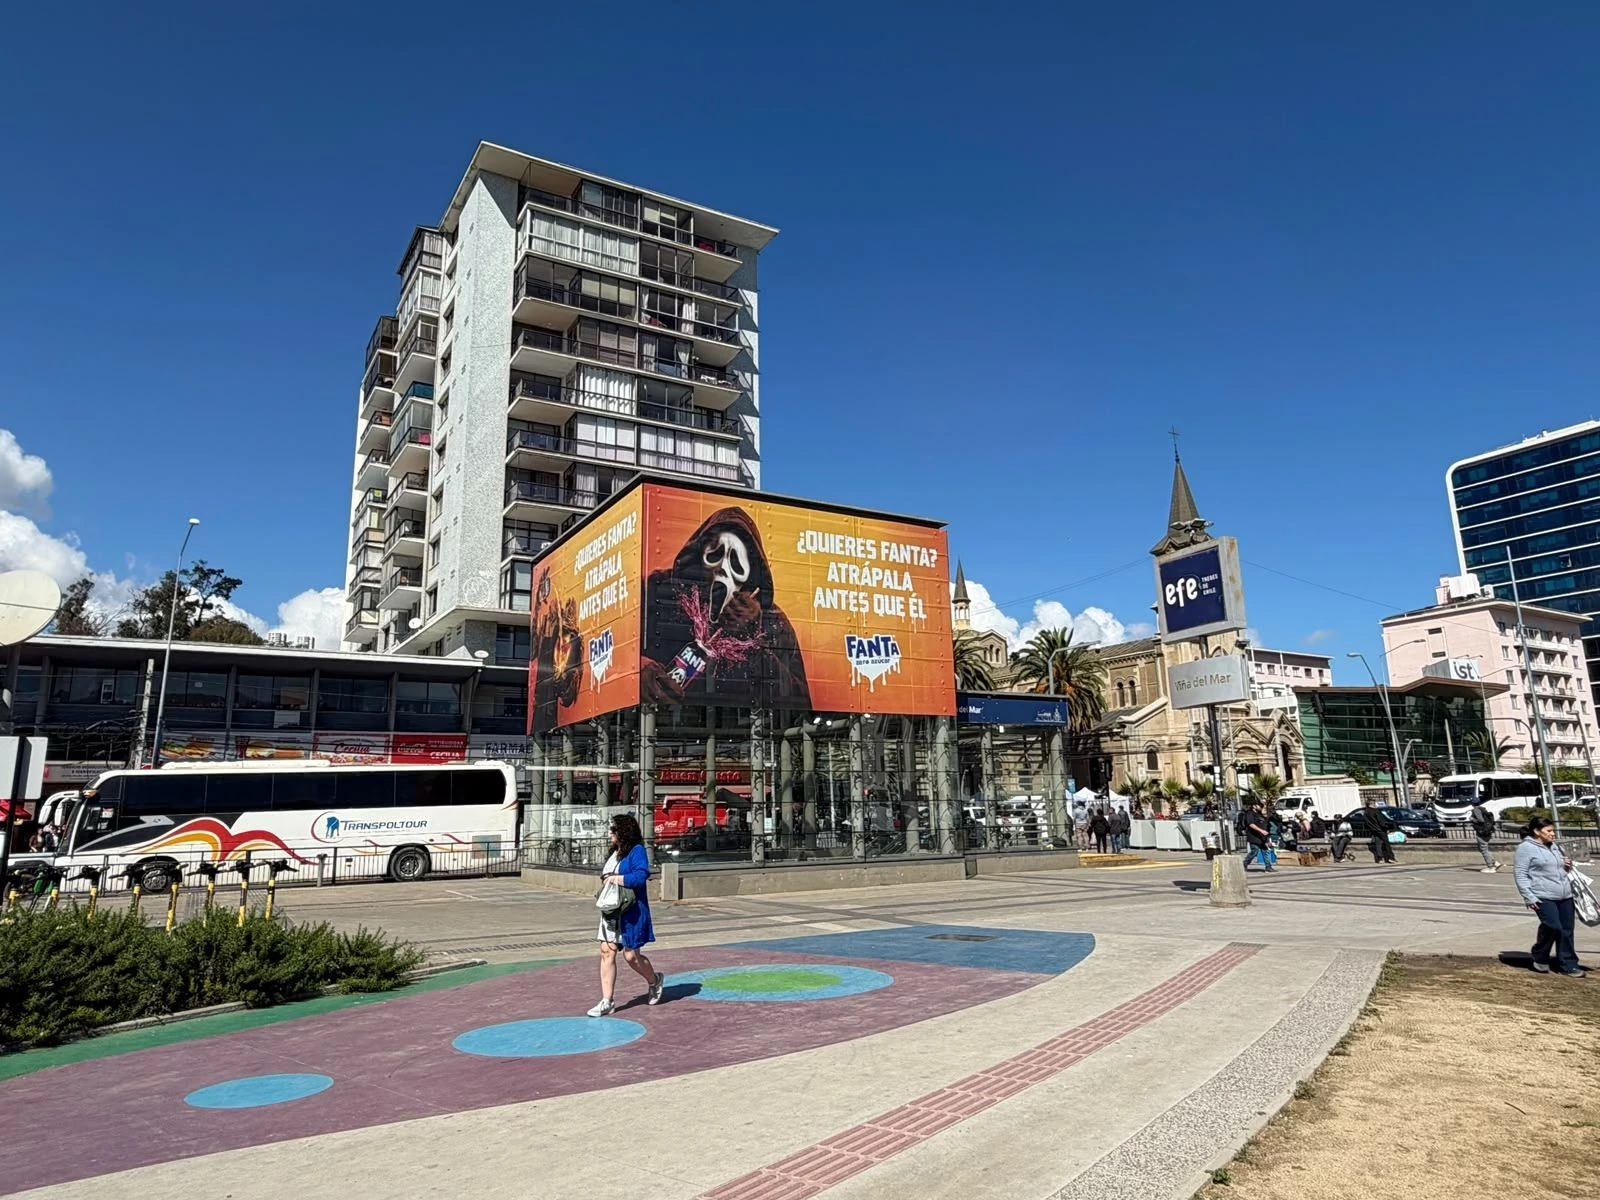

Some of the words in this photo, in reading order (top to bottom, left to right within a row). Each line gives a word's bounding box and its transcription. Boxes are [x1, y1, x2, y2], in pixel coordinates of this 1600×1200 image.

[574, 532, 606, 576] ¿QUIERES
[607, 511, 637, 550] FANTA?
[797, 530, 876, 560] ¿QUIERES
[881, 541, 938, 568] FANTA?
[584, 550, 622, 593] ATRÁPALA
[827, 561, 913, 592] ATRÁPALA
[579, 591, 601, 622] ANTES
[602, 581, 617, 611] QUE
[619, 571, 628, 602] ÉL
[813, 586, 869, 614] ANTES
[873, 593, 905, 617] QUE
[909, 592, 927, 619] ÉL
[1165, 577, 1198, 607] efe
[589, 629, 613, 662] FANTA
[846, 635, 900, 659] FANTA
[1174, 679, 1192, 692] Viña
[1193, 675, 1207, 688] del
[1210, 673, 1231, 685] Mar
[969, 705, 981, 714] Mar
[430, 751, 460, 760] CECILIA
[485, 742, 534, 755] FARMAC
[341, 820, 428, 831] TRANSPOLTOUR
